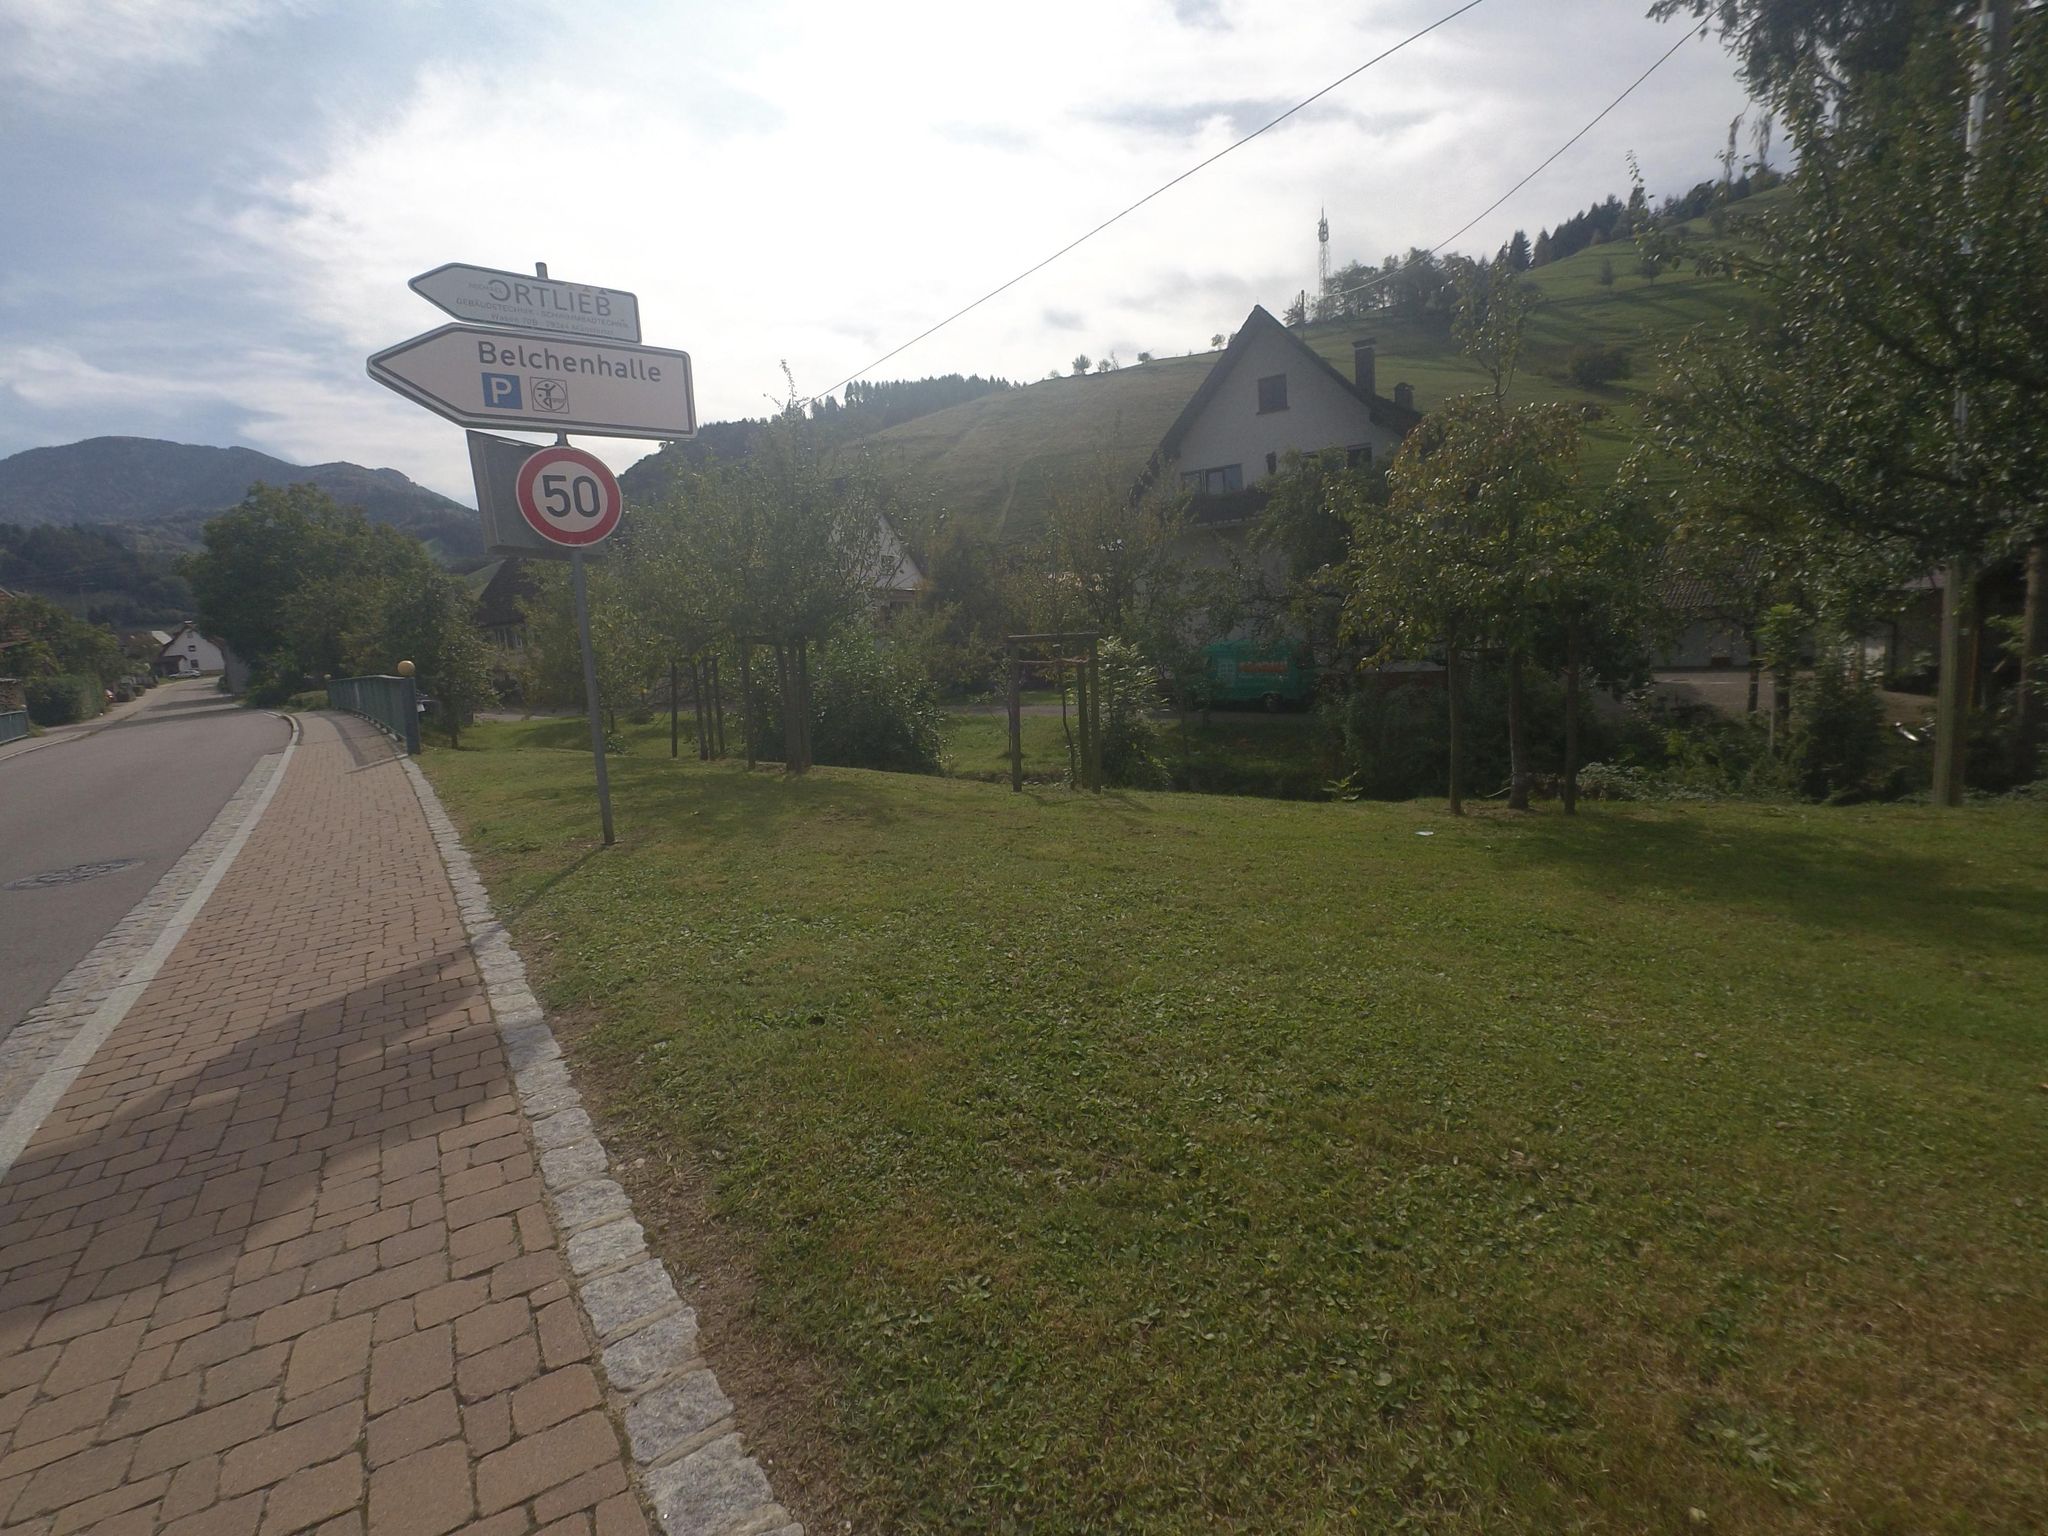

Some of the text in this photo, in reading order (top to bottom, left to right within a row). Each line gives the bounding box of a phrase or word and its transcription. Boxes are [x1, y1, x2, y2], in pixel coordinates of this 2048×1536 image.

[478, 341, 661, 382] Belchenhalle
[492, 378, 512, 404] P
[542, 475, 601, 518] 50
